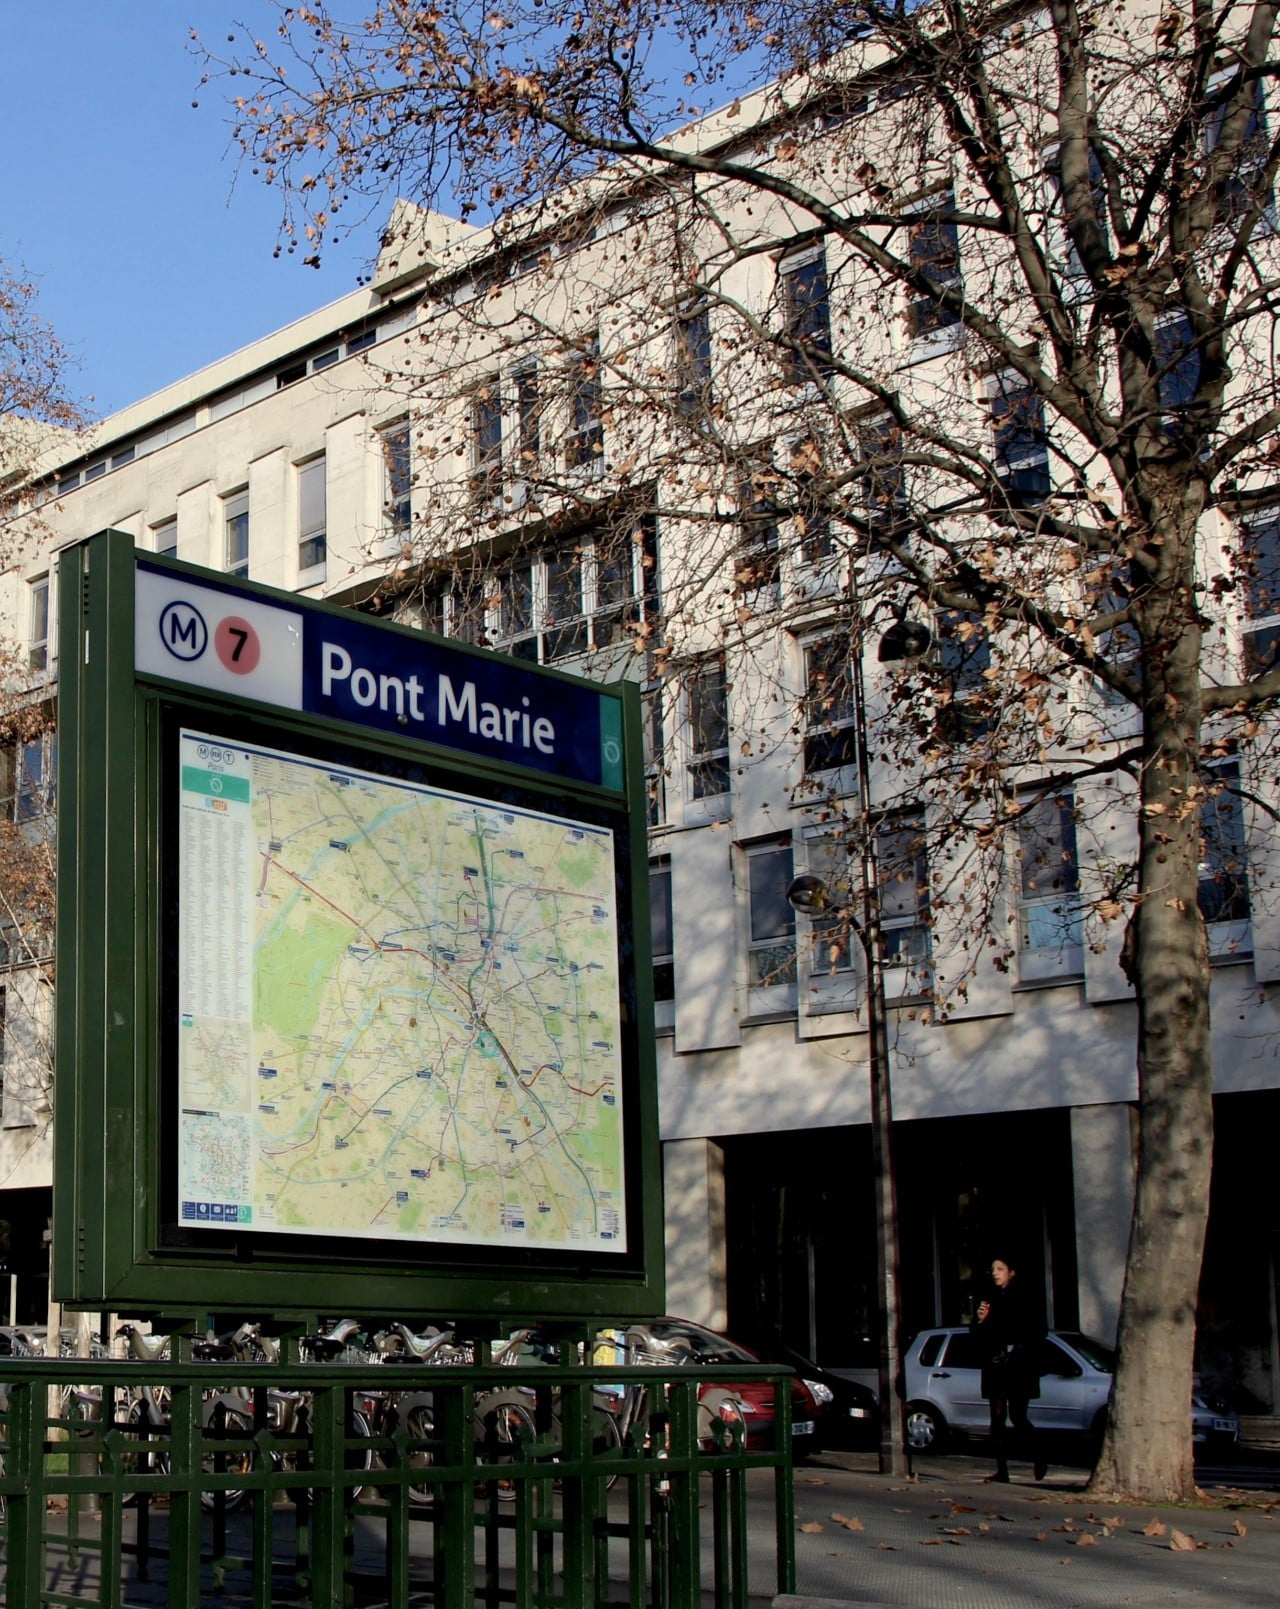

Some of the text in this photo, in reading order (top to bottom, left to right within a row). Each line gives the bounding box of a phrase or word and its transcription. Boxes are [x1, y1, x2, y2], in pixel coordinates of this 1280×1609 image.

[170, 612, 555, 754] M 7 Pont Marie
